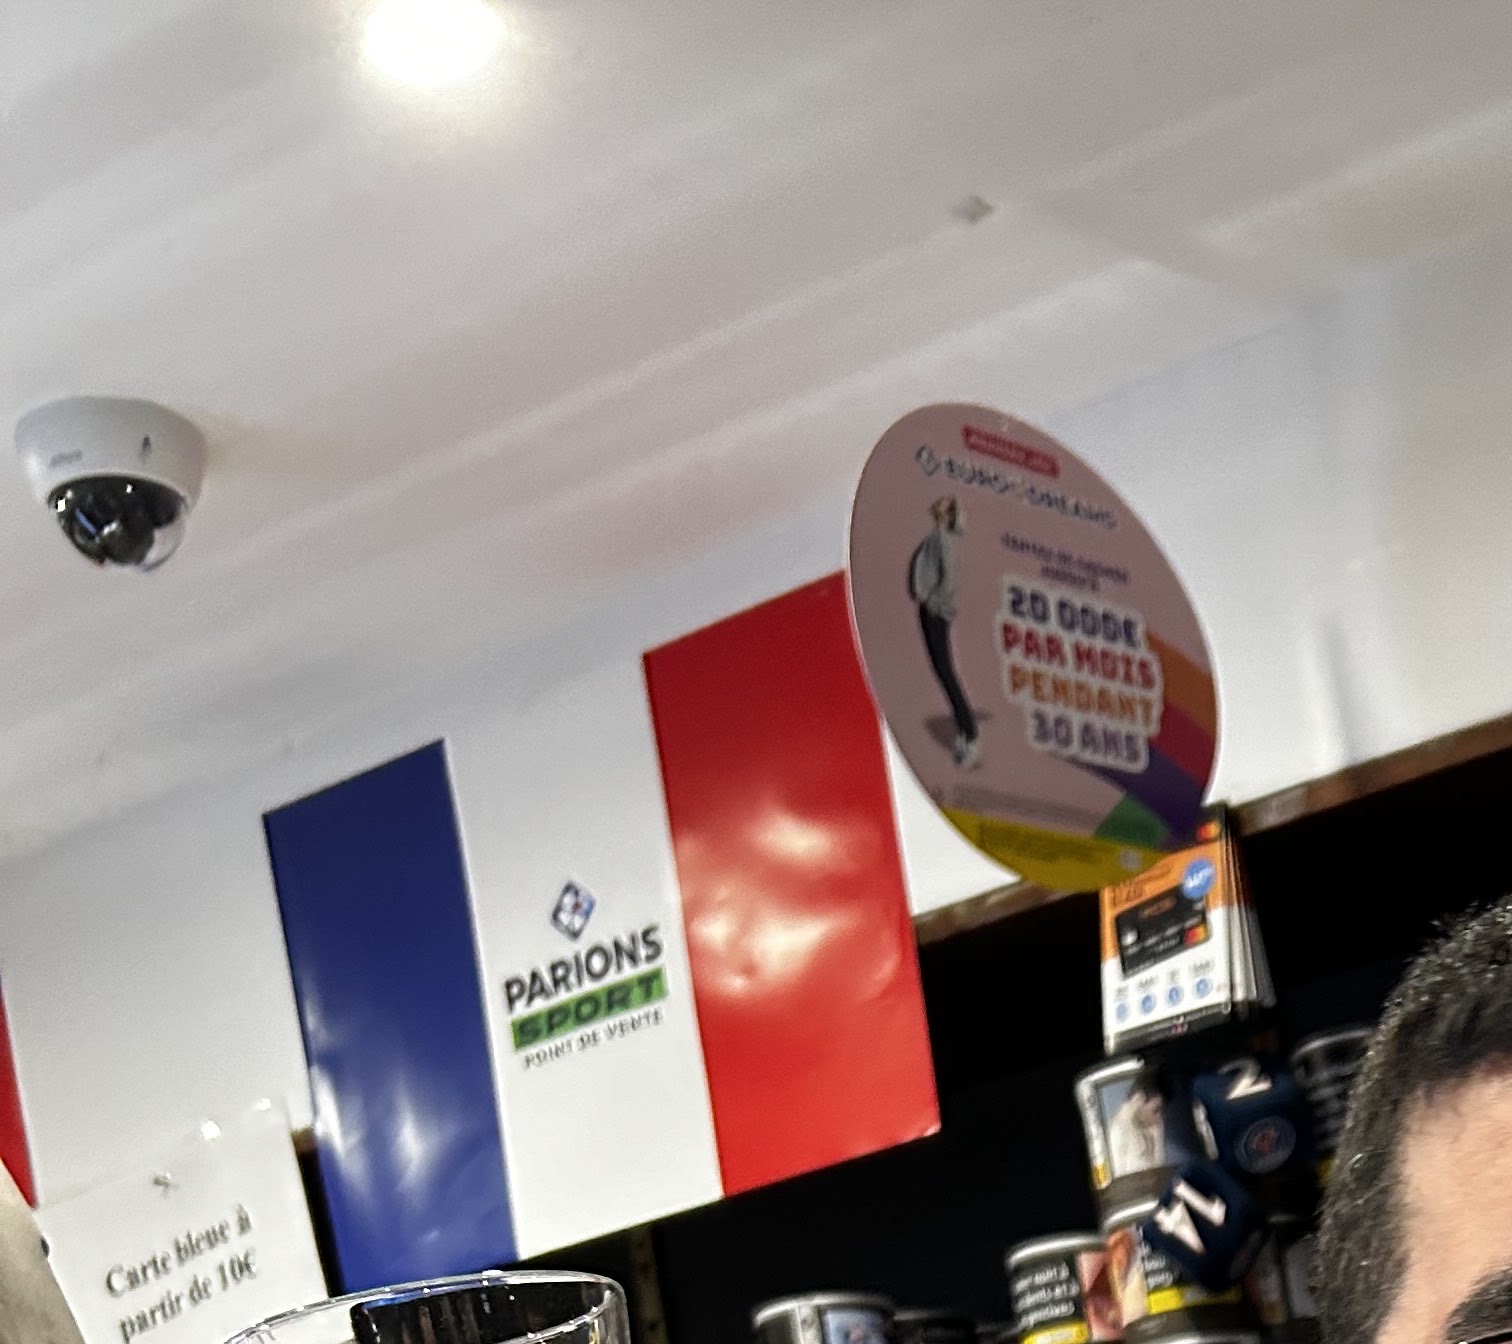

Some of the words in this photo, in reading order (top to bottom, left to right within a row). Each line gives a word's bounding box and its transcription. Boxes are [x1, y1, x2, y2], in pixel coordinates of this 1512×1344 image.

[1008, 585, 1051, 620] 20
[1002, 623, 1066, 665] PAR
[1074, 643, 1157, 689] MOIS
[1007, 663, 1156, 725] PENDANT
[1030, 709, 1074, 747] 30
[1080, 721, 1142, 764] ANS
[504, 923, 664, 1015] PARIONS
[519, 973, 661, 1045] SPORT
[523, 1040, 574, 1071] POINT
[578, 1031, 601, 1051] DE
[606, 1006, 663, 1040] VENTE
[106, 1250, 171, 1299] Carte
[174, 1219, 230, 1267] bleue
[235, 1203, 252, 1236] à
[188, 1274, 213, 1302] de
[215, 1247, 258, 1292] 10€
